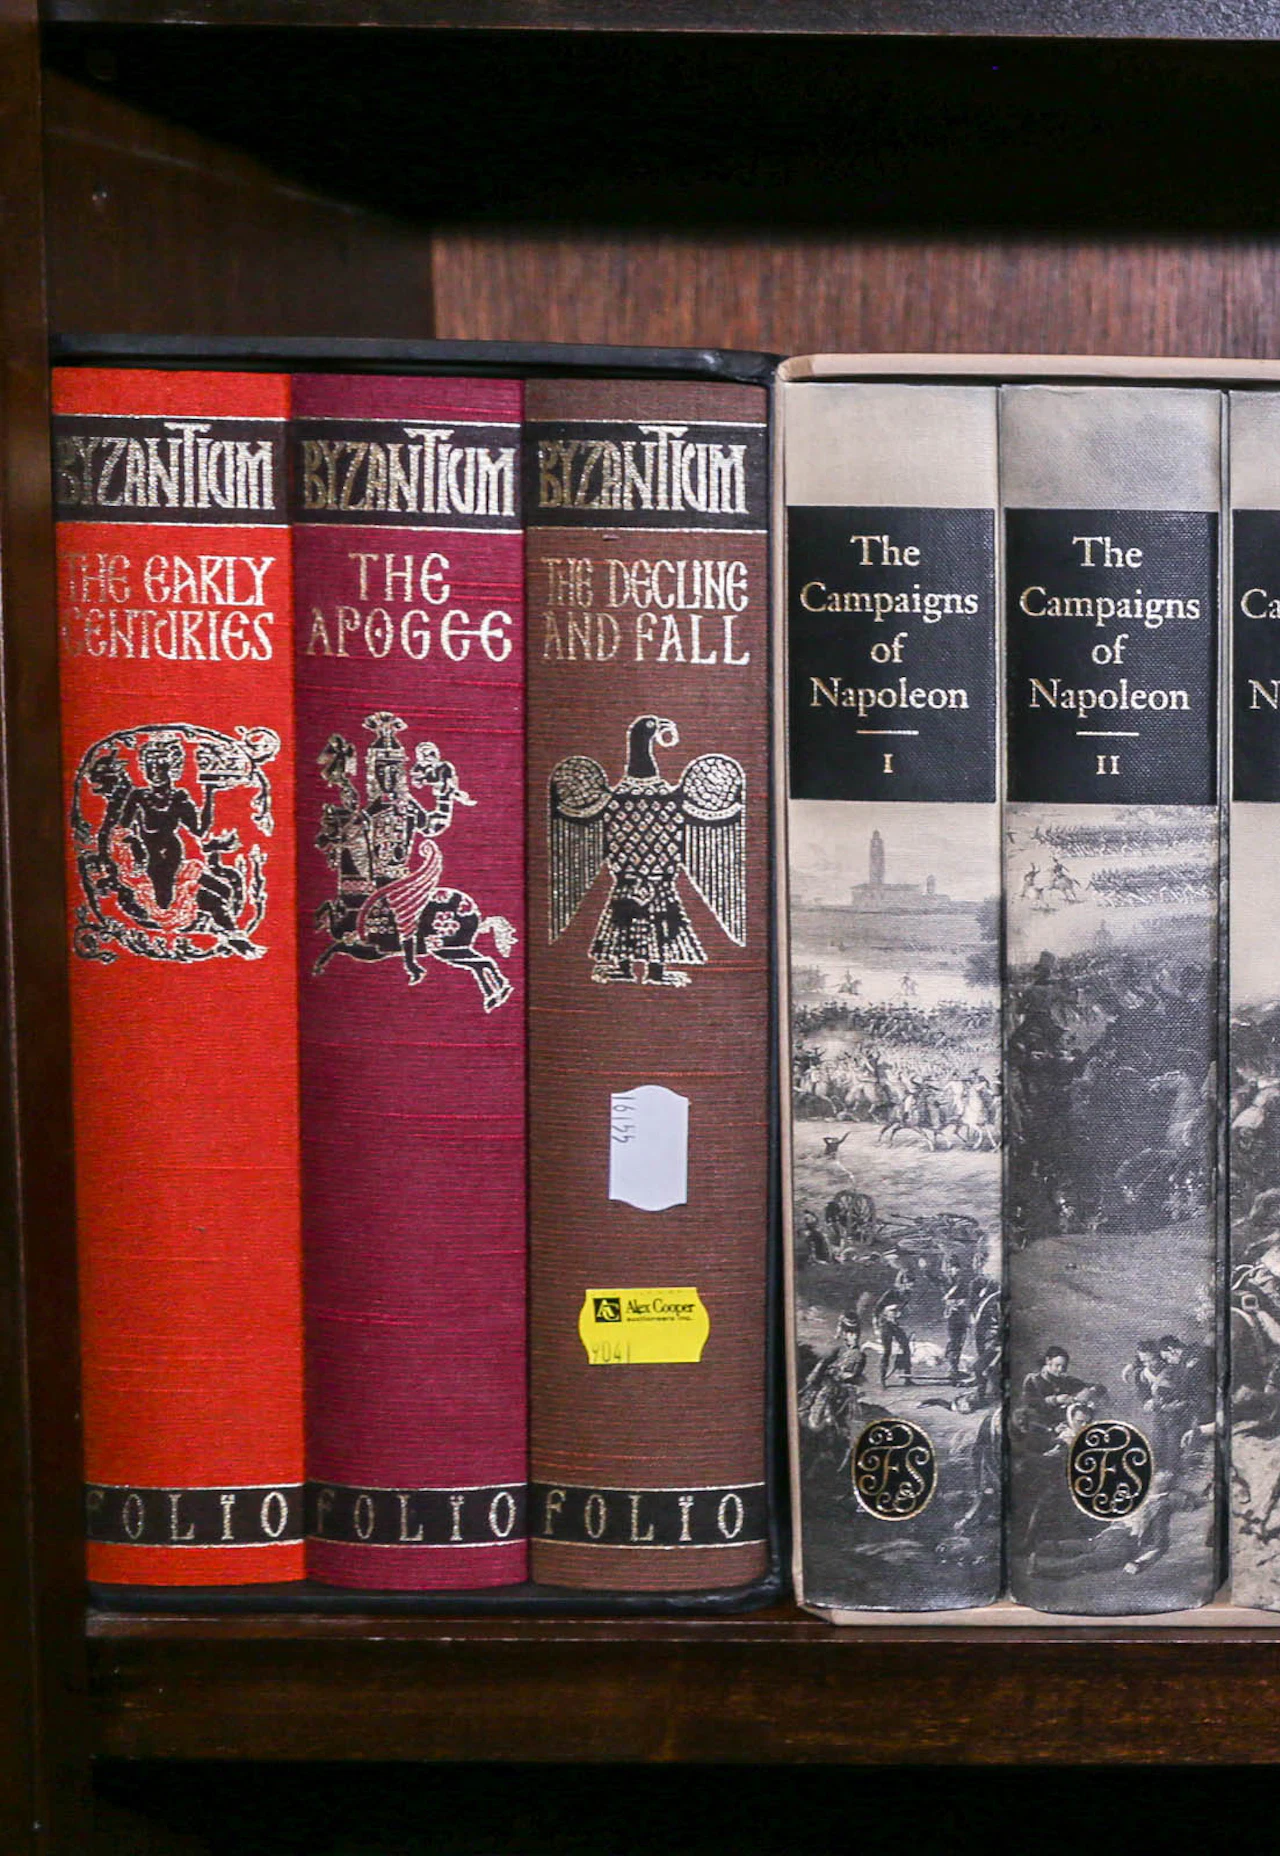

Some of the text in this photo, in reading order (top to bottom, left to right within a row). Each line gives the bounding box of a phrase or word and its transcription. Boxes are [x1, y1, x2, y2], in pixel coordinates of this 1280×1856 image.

[303, 427, 516, 517] BYZANTIUM
[538, 425, 749, 515] BYZANTIUM
[850, 535, 921, 568] The
[1072, 536, 1143, 570] The
[59, 553, 276, 606] THE EARLY
[349, 552, 451, 605] THE
[541, 556, 748, 611] THE DECLINE
[800, 581, 978, 622] Campaigns
[1020, 586, 1200, 626] Campaigns
[61, 607, 274, 661] CENTURIES
[306, 606, 513, 662] APOGEE
[542, 611, 750, 666] AND FALL
[870, 632, 907, 664] of
[1091, 633, 1129, 665] of
[810, 677, 970, 717] Napoleon
[1029, 678, 1190, 718] Napoleon
[883, 753, 894, 774] I
[1096, 755, 1120, 775] II
[627, 1298, 695, 1316] Alex Cooper
